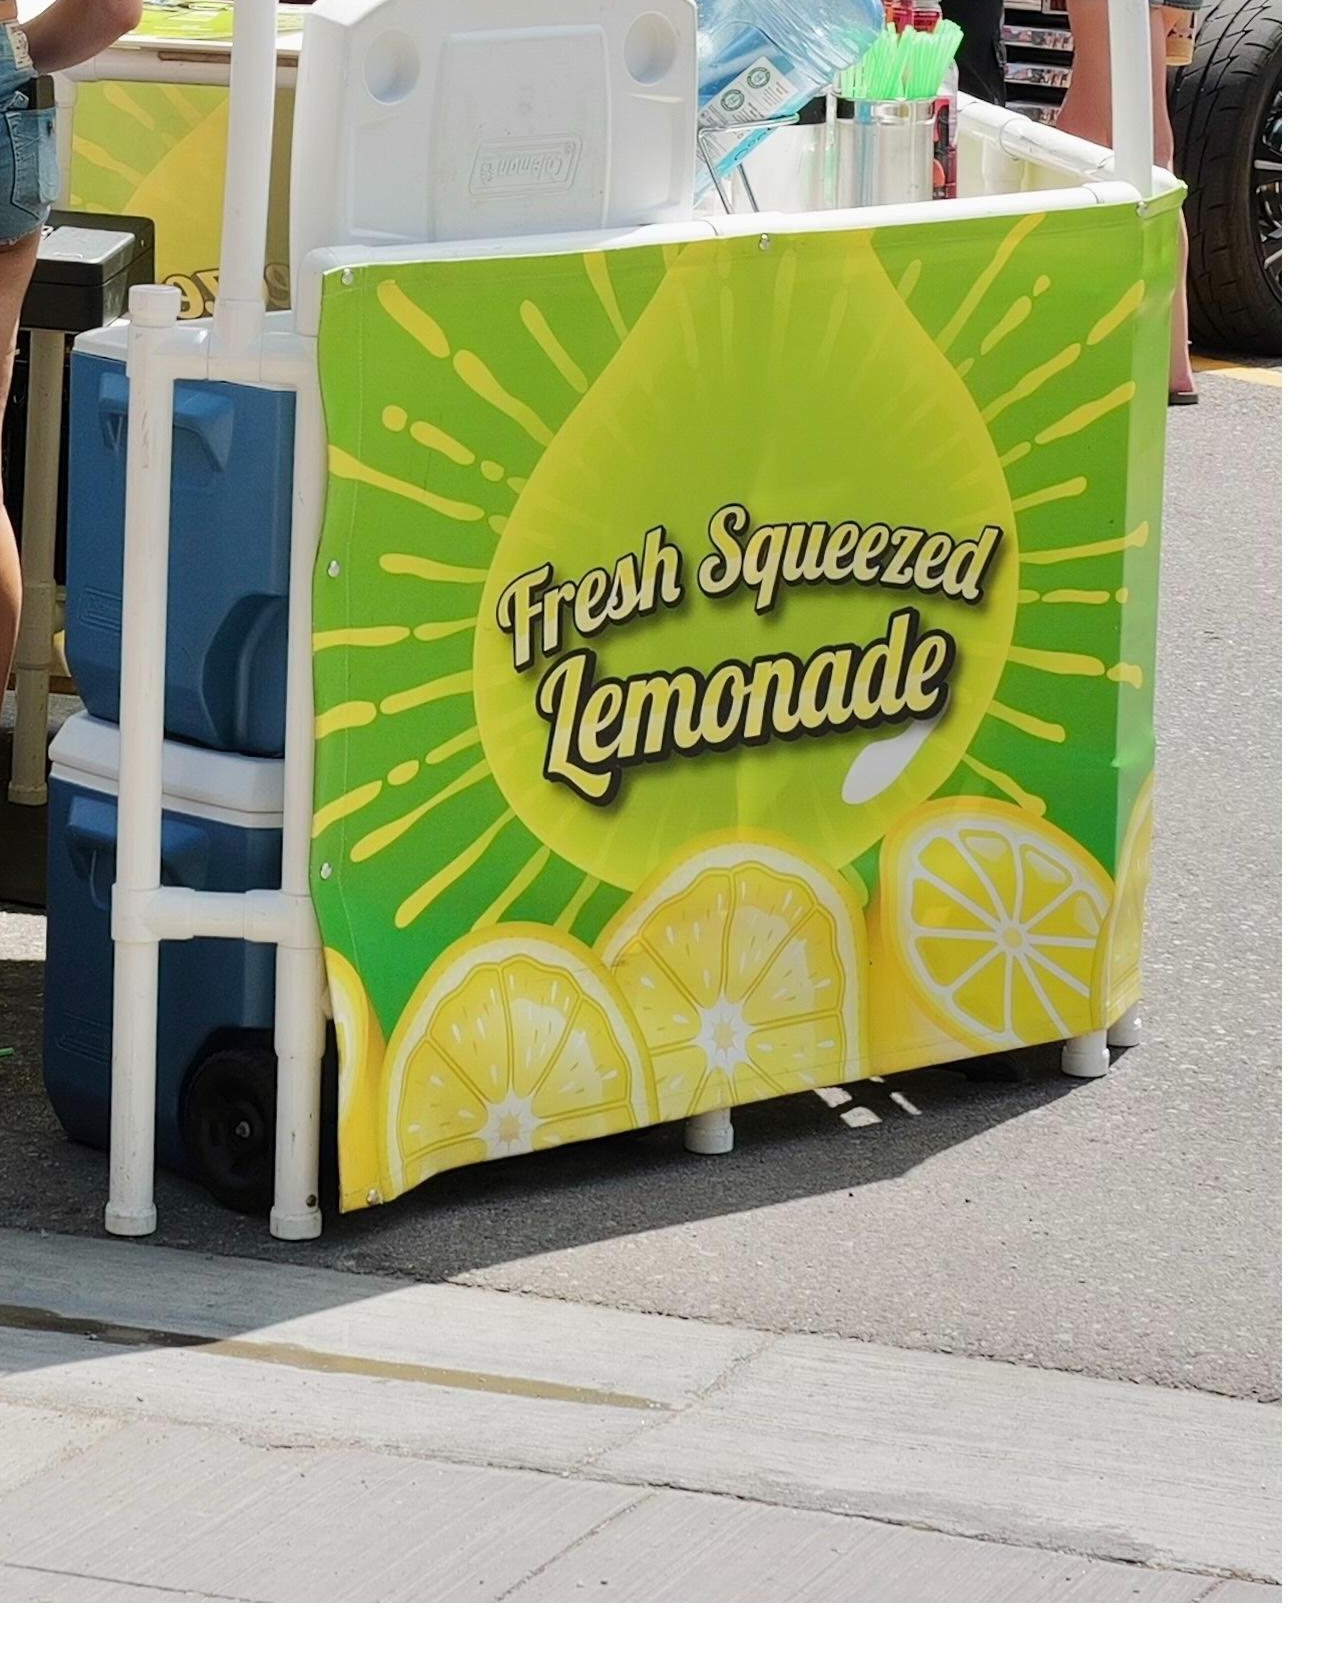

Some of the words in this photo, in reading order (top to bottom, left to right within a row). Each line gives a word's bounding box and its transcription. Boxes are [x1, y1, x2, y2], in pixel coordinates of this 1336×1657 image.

[496, 525, 681, 670] Fresh
[698, 504, 1003, 612] Squeezed
[535, 612, 953, 805] Lemonade
